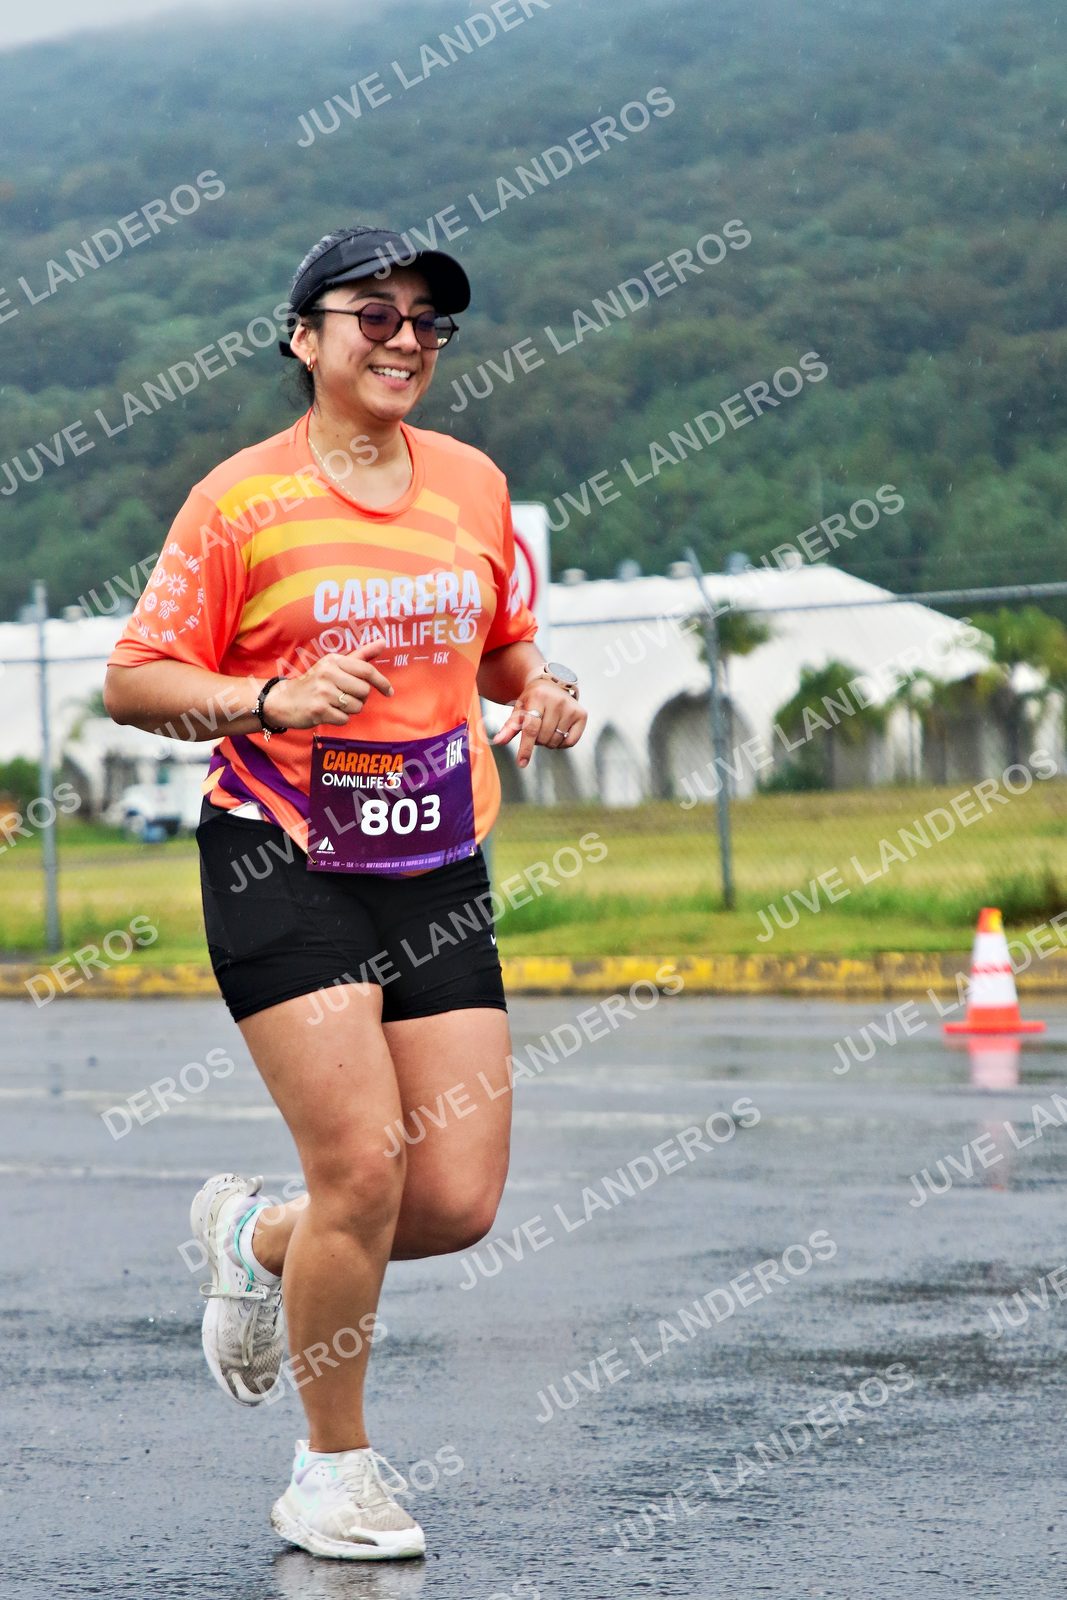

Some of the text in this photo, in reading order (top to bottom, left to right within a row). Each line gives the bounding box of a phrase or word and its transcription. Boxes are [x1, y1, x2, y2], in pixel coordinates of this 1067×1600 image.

[314, 570, 483, 623] CARRERA
[394, 654, 409, 666] 10K
[323, 750, 404, 774] CARRERA
[445, 737, 464, 769] 15K
[361, 794, 441, 836] 803
